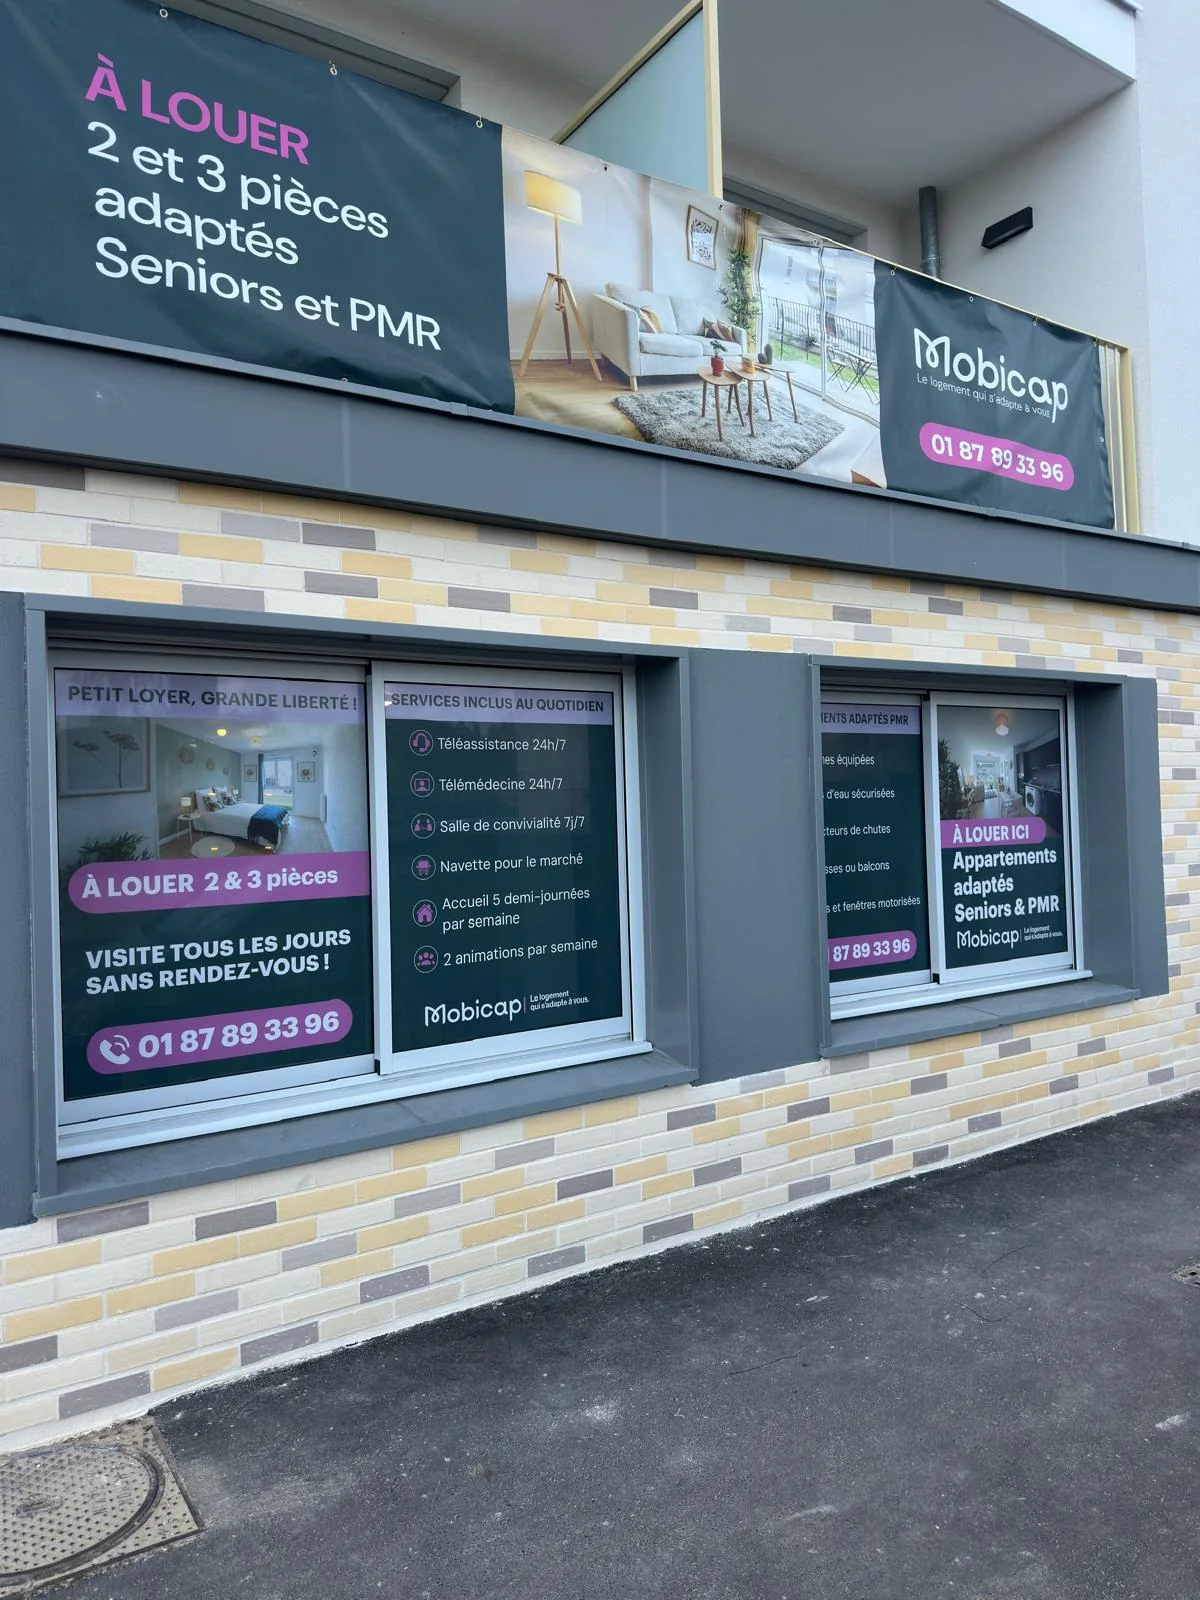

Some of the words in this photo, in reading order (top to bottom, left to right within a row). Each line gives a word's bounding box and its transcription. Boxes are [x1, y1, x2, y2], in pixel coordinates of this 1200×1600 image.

[85, 53, 127, 111] À
[142, 79, 309, 165] LOUER
[88, 122, 119, 163] 2
[133, 147, 184, 183] et
[197, 154, 226, 193] 3
[241, 173, 389, 239] pièces
[95, 186, 299, 265] adaptés
[96, 236, 283, 311] Seniors
[295, 294, 340, 327] et
[350, 297, 441, 350] PMR
[913, 328, 1068, 423] Mobicap
[916, 373, 928, 384] Le
[930, 377, 970, 396] logement
[973, 390, 987, 402] qui
[989, 393, 1023, 412] s'adapte
[1025, 403, 1030, 413] à
[931, 433, 953, 457] 01
[959, 441, 984, 462] 87
[991, 447, 1013, 469] 89
[1016, 454, 1036, 476] 33
[1040, 461, 1064, 482] 96
[68, 685, 123, 701] PETIT
[129, 687, 196, 706] LOYER,
[201, 691, 278, 707] GRANDE
[283, 694, 349, 710] LIBERTÉ
[391, 693, 460, 708] SERVICES
[464, 696, 513, 710] INCLUS
[516, 698, 534, 711] AU
[536, 699, 604, 713] QUOTIDIEN
[848, 711, 889, 725] ADAPTÉS
[890, 714, 909, 726] PMR
[437, 737, 529, 751] Téléassistance
[532, 739, 567, 752] 24h/7
[837, 753, 875, 768] équipées
[438, 777, 526, 792] Télémédecine
[529, 777, 563, 791] 24h/7
[826, 788, 850, 800] d'eau
[851, 788, 895, 799] sécurisées
[440, 819, 470, 833] Salle
[473, 818, 490, 832] de
[493, 815, 561, 831] convivialité
[563, 816, 585, 831] 7j/7
[850, 824, 861, 835] de
[863, 824, 891, 835] chutes
[952, 824, 963, 844] À
[965, 825, 1009, 843] LOUER
[1011, 824, 1029, 840] ICI
[440, 858, 491, 873] Navette
[494, 857, 523, 873] pour
[526, 855, 537, 868] le
[540, 852, 583, 867] marché
[845, 864, 856, 873] ou
[857, 861, 890, 873] balcons
[953, 848, 1057, 872] Appartements
[81, 874, 102, 899] À
[108, 874, 195, 897] LOUER
[204, 873, 220, 892] 2
[224, 871, 242, 890] &
[247, 870, 262, 888] 3
[267, 867, 339, 892] pièces
[953, 873, 1014, 898] adaptés
[442, 894, 489, 910] Accueil
[492, 893, 500, 906] 5
[504, 887, 591, 905] demi-journées
[832, 902, 841, 913] et
[843, 899, 877, 912] fenêtres
[878, 895, 921, 908] motorisées
[954, 900, 1012, 923] Seniors
[1014, 898, 1026, 916] &
[1028, 895, 1060, 914] PMR
[442, 918, 465, 934] par
[468, 912, 520, 929] semaine
[86, 946, 165, 969] VISITE
[169, 940, 234, 963] TOUS
[239, 936, 278, 955] LES
[283, 929, 352, 952] JOURS
[832, 944, 850, 963] 87
[852, 942, 871, 959] 89
[873, 940, 891, 957] 33
[892, 938, 911, 954] 96
[956, 928, 1019, 949] Mobicap
[443, 953, 452, 967] 2
[455, 945, 524, 965] animations
[527, 944, 547, 959] par
[550, 938, 598, 953] semaine
[86, 971, 154, 995] SANS
[159, 955, 318, 988] RENDEZ-VOUS
[530, 994, 538, 1003] Le
[539, 990, 569, 1001] logement
[530, 1002, 541, 1011] qui
[541, 998, 568, 1009] s'adapte
[424, 998, 522, 1028] Mobicap
[138, 1033, 173, 1059] 01
[180, 1028, 216, 1054] 87
[221, 1022, 258, 1048] 89
[264, 1016, 299, 1041] 33
[305, 1011, 340, 1035] 96
